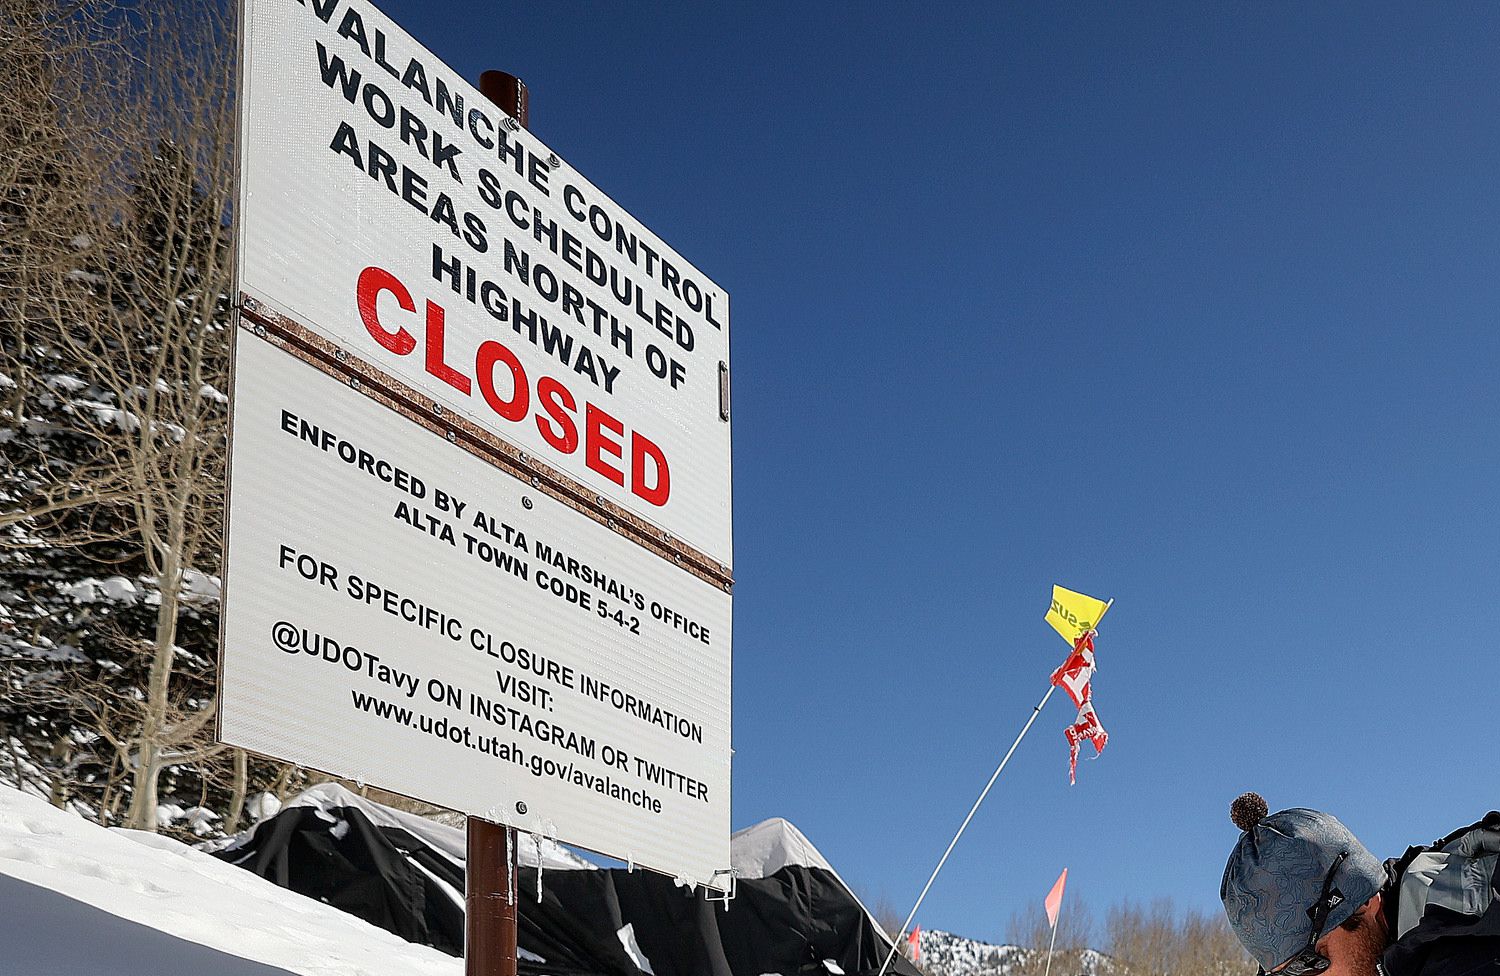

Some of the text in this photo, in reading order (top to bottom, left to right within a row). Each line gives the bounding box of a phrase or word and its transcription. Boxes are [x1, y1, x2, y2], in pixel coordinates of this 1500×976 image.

[297, 0, 720, 330] VALANCHE CONTROL
[315, 40, 694, 352] WORK SCHEDULED
[330, 121, 685, 390] AREAS NORTH OF
[358, 267, 669, 506] CLOSED
[433, 243, 620, 395] HIGHWAY
[282, 409, 709, 645] ENFORCED BY ALTA MARSHAL'S OFFICE
[394, 502, 639, 635] ALTA TOWN CODE 5-4-2
[272, 622, 708, 802] @UDOTavy ON INSTAGRAM OR TWITTER
[280, 545, 701, 743] FOR SPECIFIC CLOSURE INFORMATION
[497, 671, 552, 712] VISIT:
[352, 690, 661, 813] www.udot.utah.gov/avalanche
